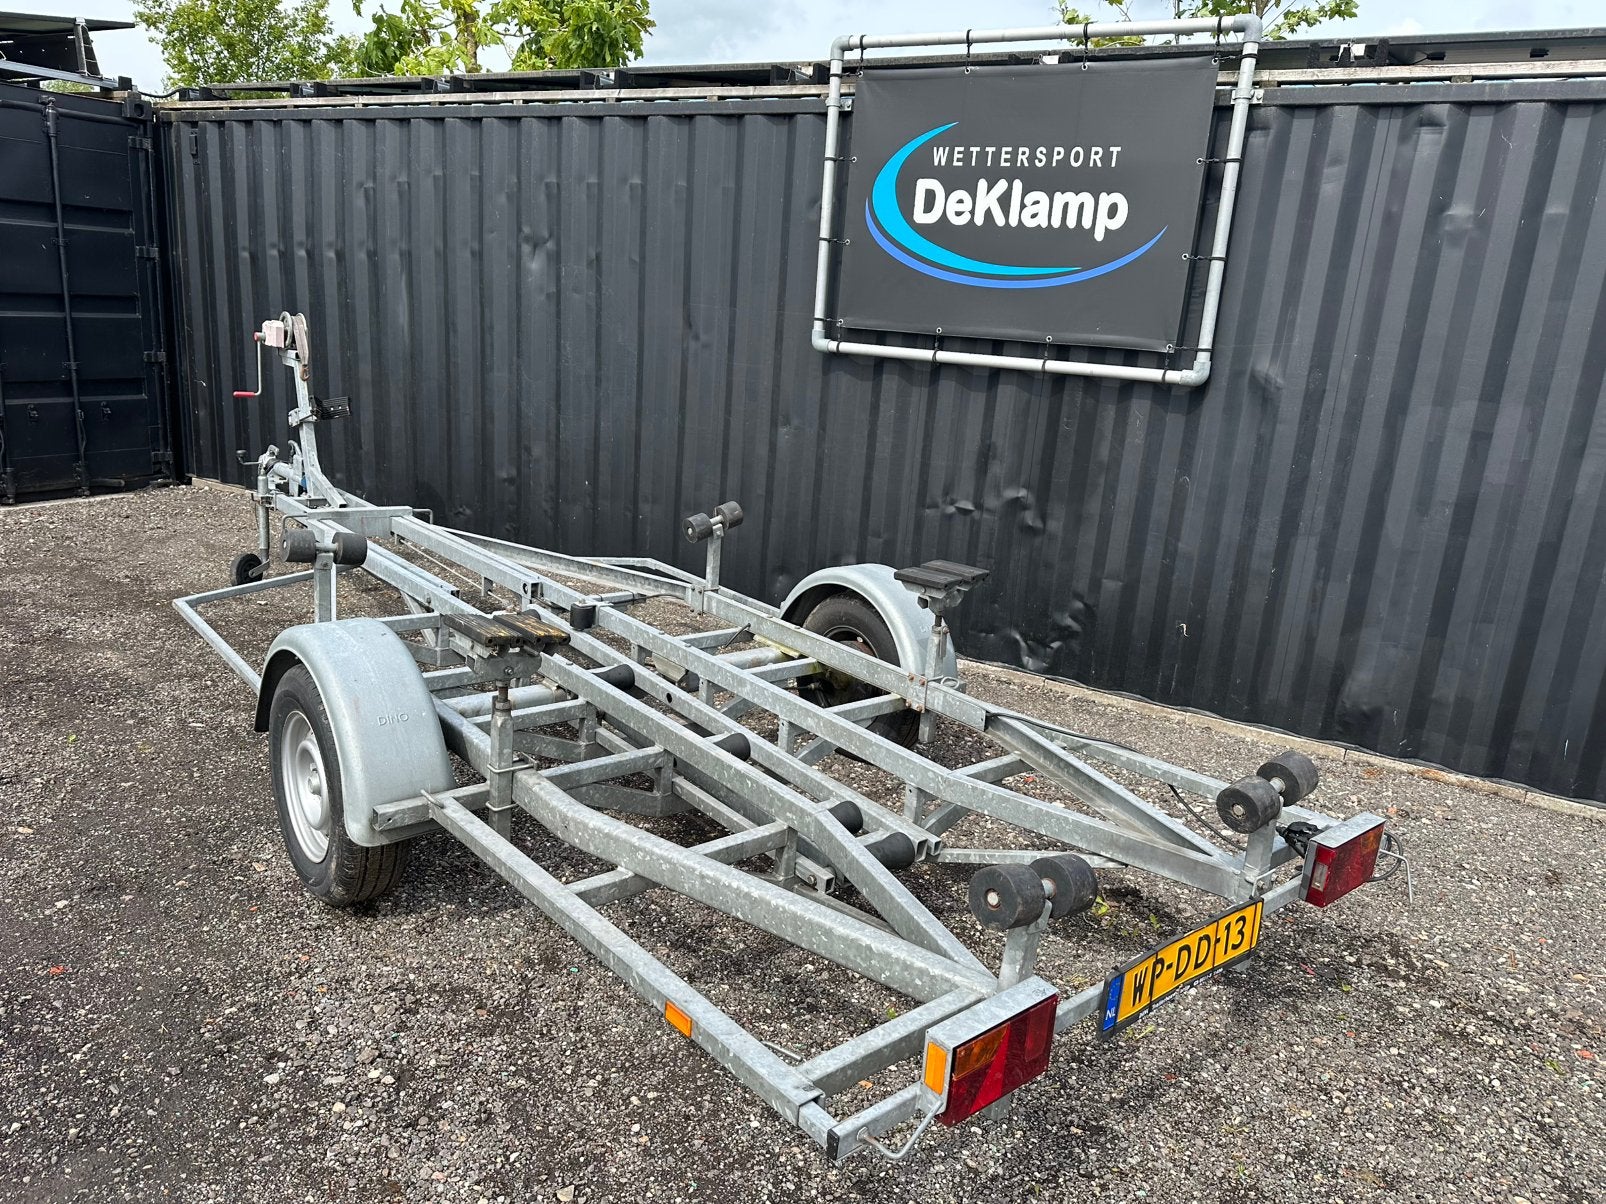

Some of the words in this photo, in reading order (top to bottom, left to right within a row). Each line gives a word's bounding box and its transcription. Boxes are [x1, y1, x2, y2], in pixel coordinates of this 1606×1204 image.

[932, 145, 1122, 168] WETTERSPORT
[912, 177, 1129, 242] DeKlamp
[1131, 914, 1248, 1008] WP-DD-13
[1105, 1008, 1116, 1021] NL
